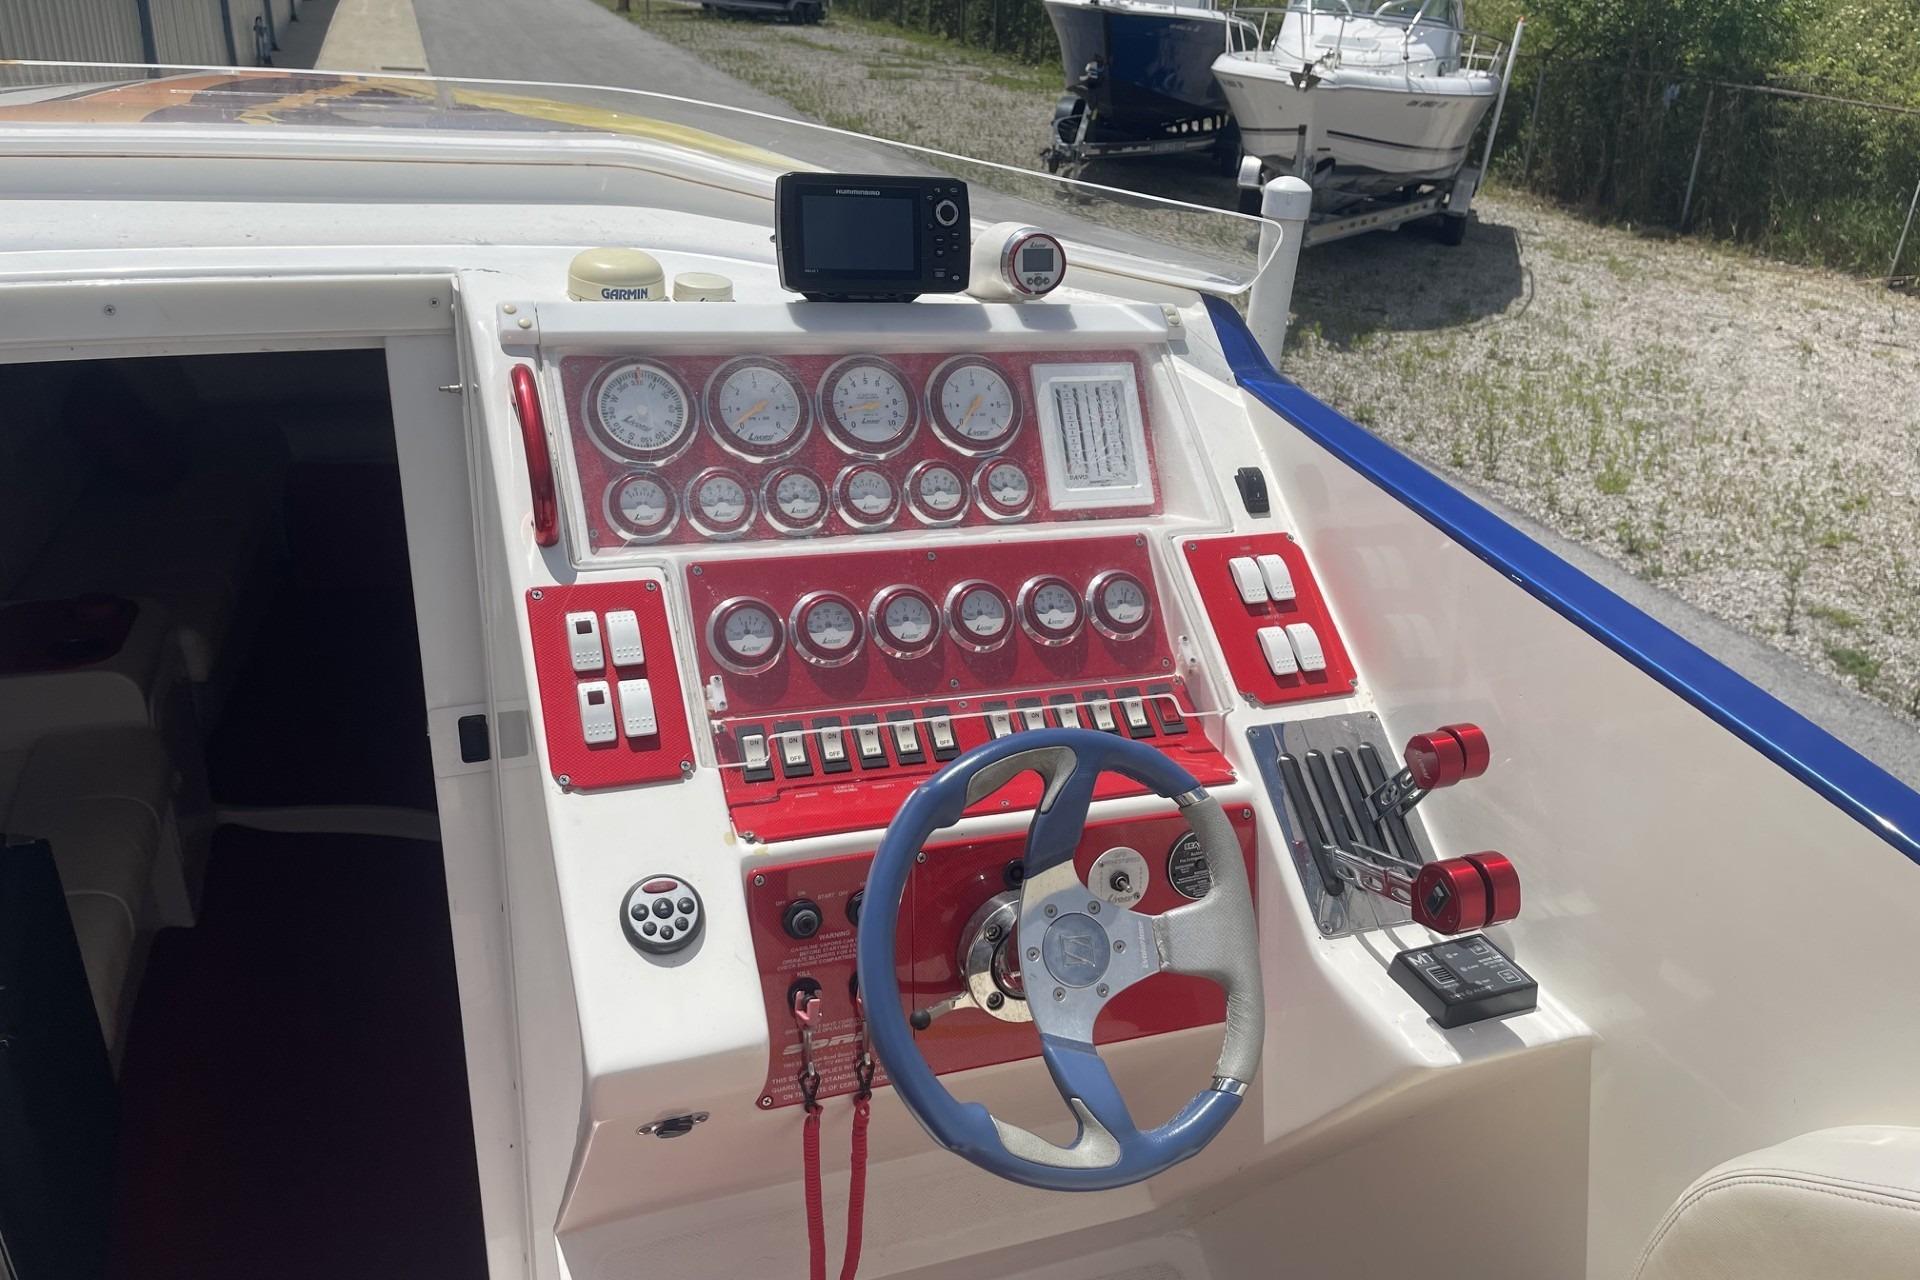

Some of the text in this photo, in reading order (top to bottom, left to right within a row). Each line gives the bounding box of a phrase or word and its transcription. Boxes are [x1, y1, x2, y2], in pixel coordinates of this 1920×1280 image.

[601, 288, 648, 300] GARMIN
[818, 930, 850, 941] WARNING
[772, 1077, 789, 1085] THIS
[771, 1085, 796, 1094] GUARD
